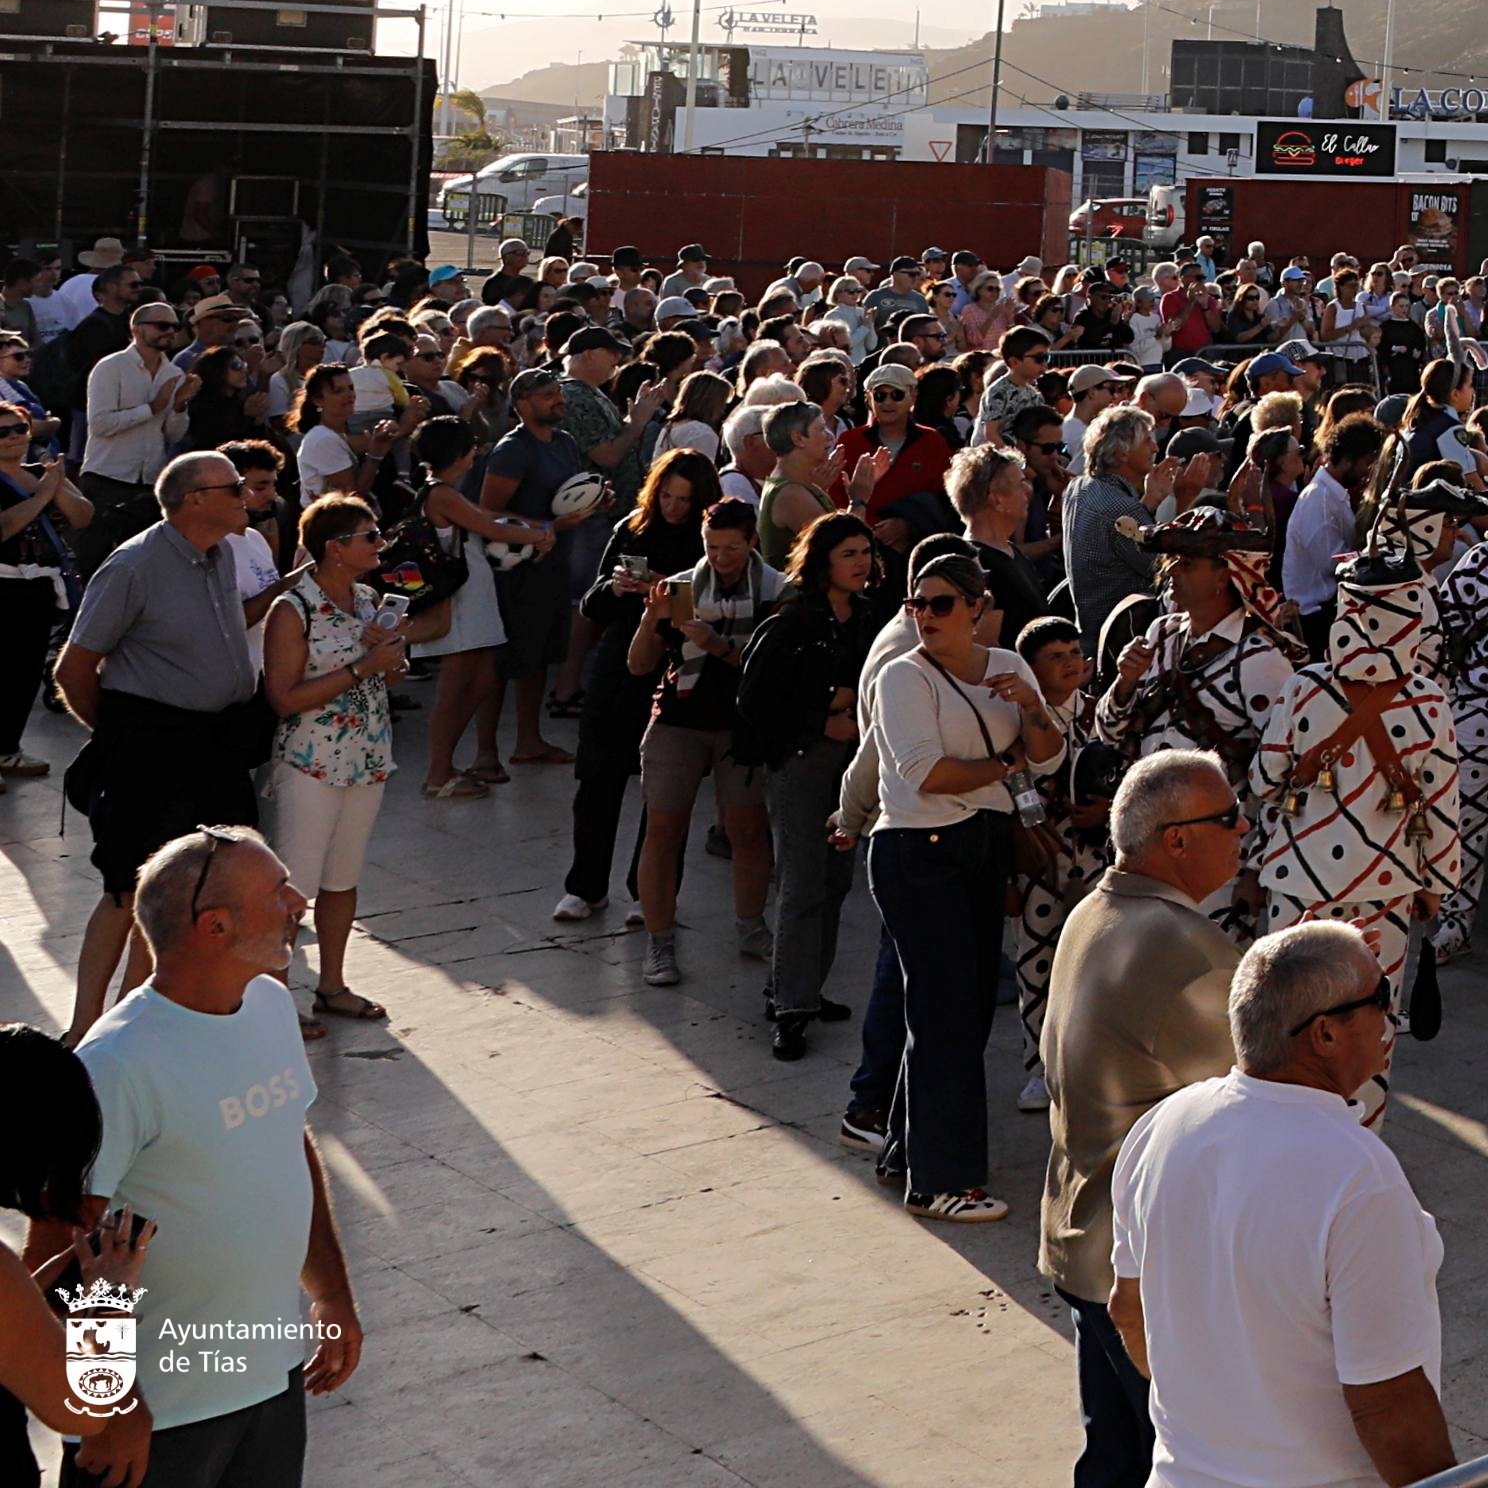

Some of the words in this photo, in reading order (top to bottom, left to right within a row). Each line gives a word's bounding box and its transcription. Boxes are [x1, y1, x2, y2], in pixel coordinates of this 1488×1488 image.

[740, 12, 758, 22] LA
[762, 13, 818, 25] VELETA
[753, 62, 787, 86] LA
[1391, 86, 1434, 113] LA
[1321, 133, 1339, 153] El
[1412, 194, 1440, 211] BACON
[1441, 195, 1458, 213] BITS
[218, 1067, 302, 1132] BOSS
